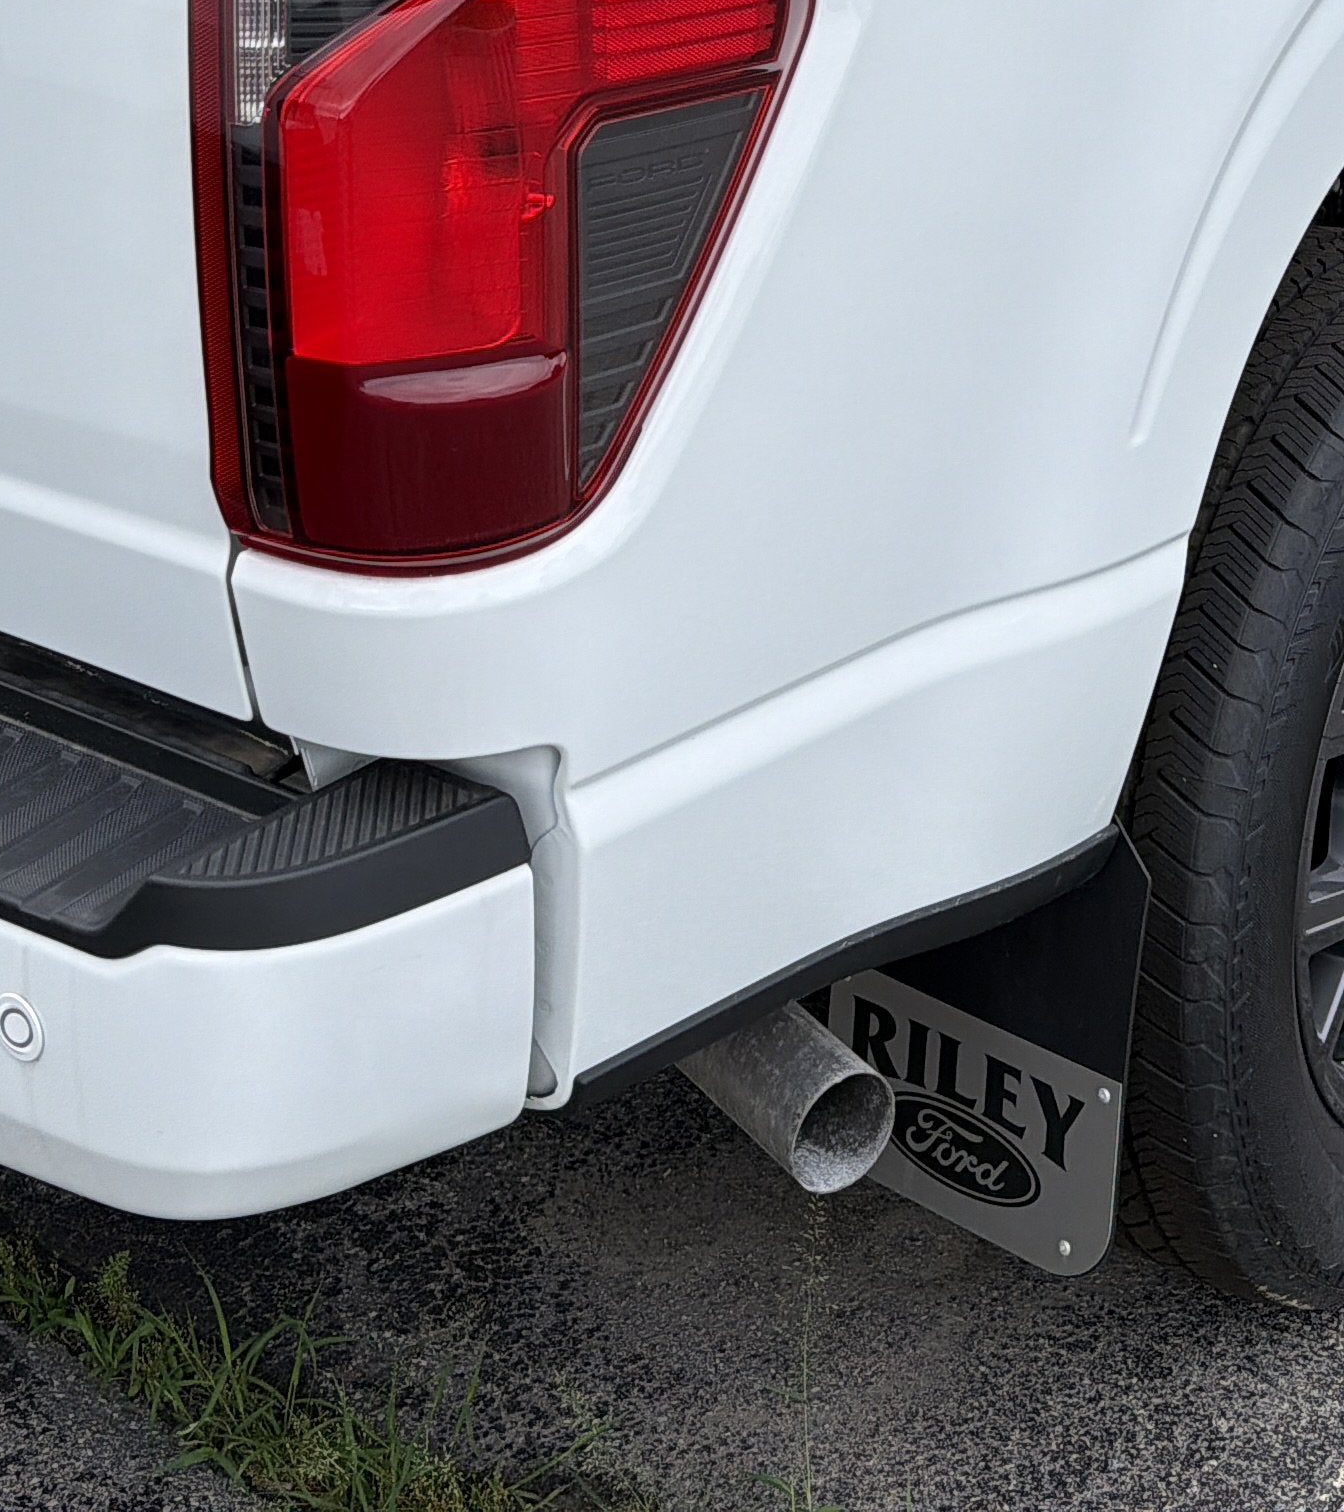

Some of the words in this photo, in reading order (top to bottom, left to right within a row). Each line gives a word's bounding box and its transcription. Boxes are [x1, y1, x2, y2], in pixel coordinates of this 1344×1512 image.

[587, 151, 708, 192] FORD
[851, 993, 1086, 1173] RILEY
[905, 1107, 1008, 1193] Ford
